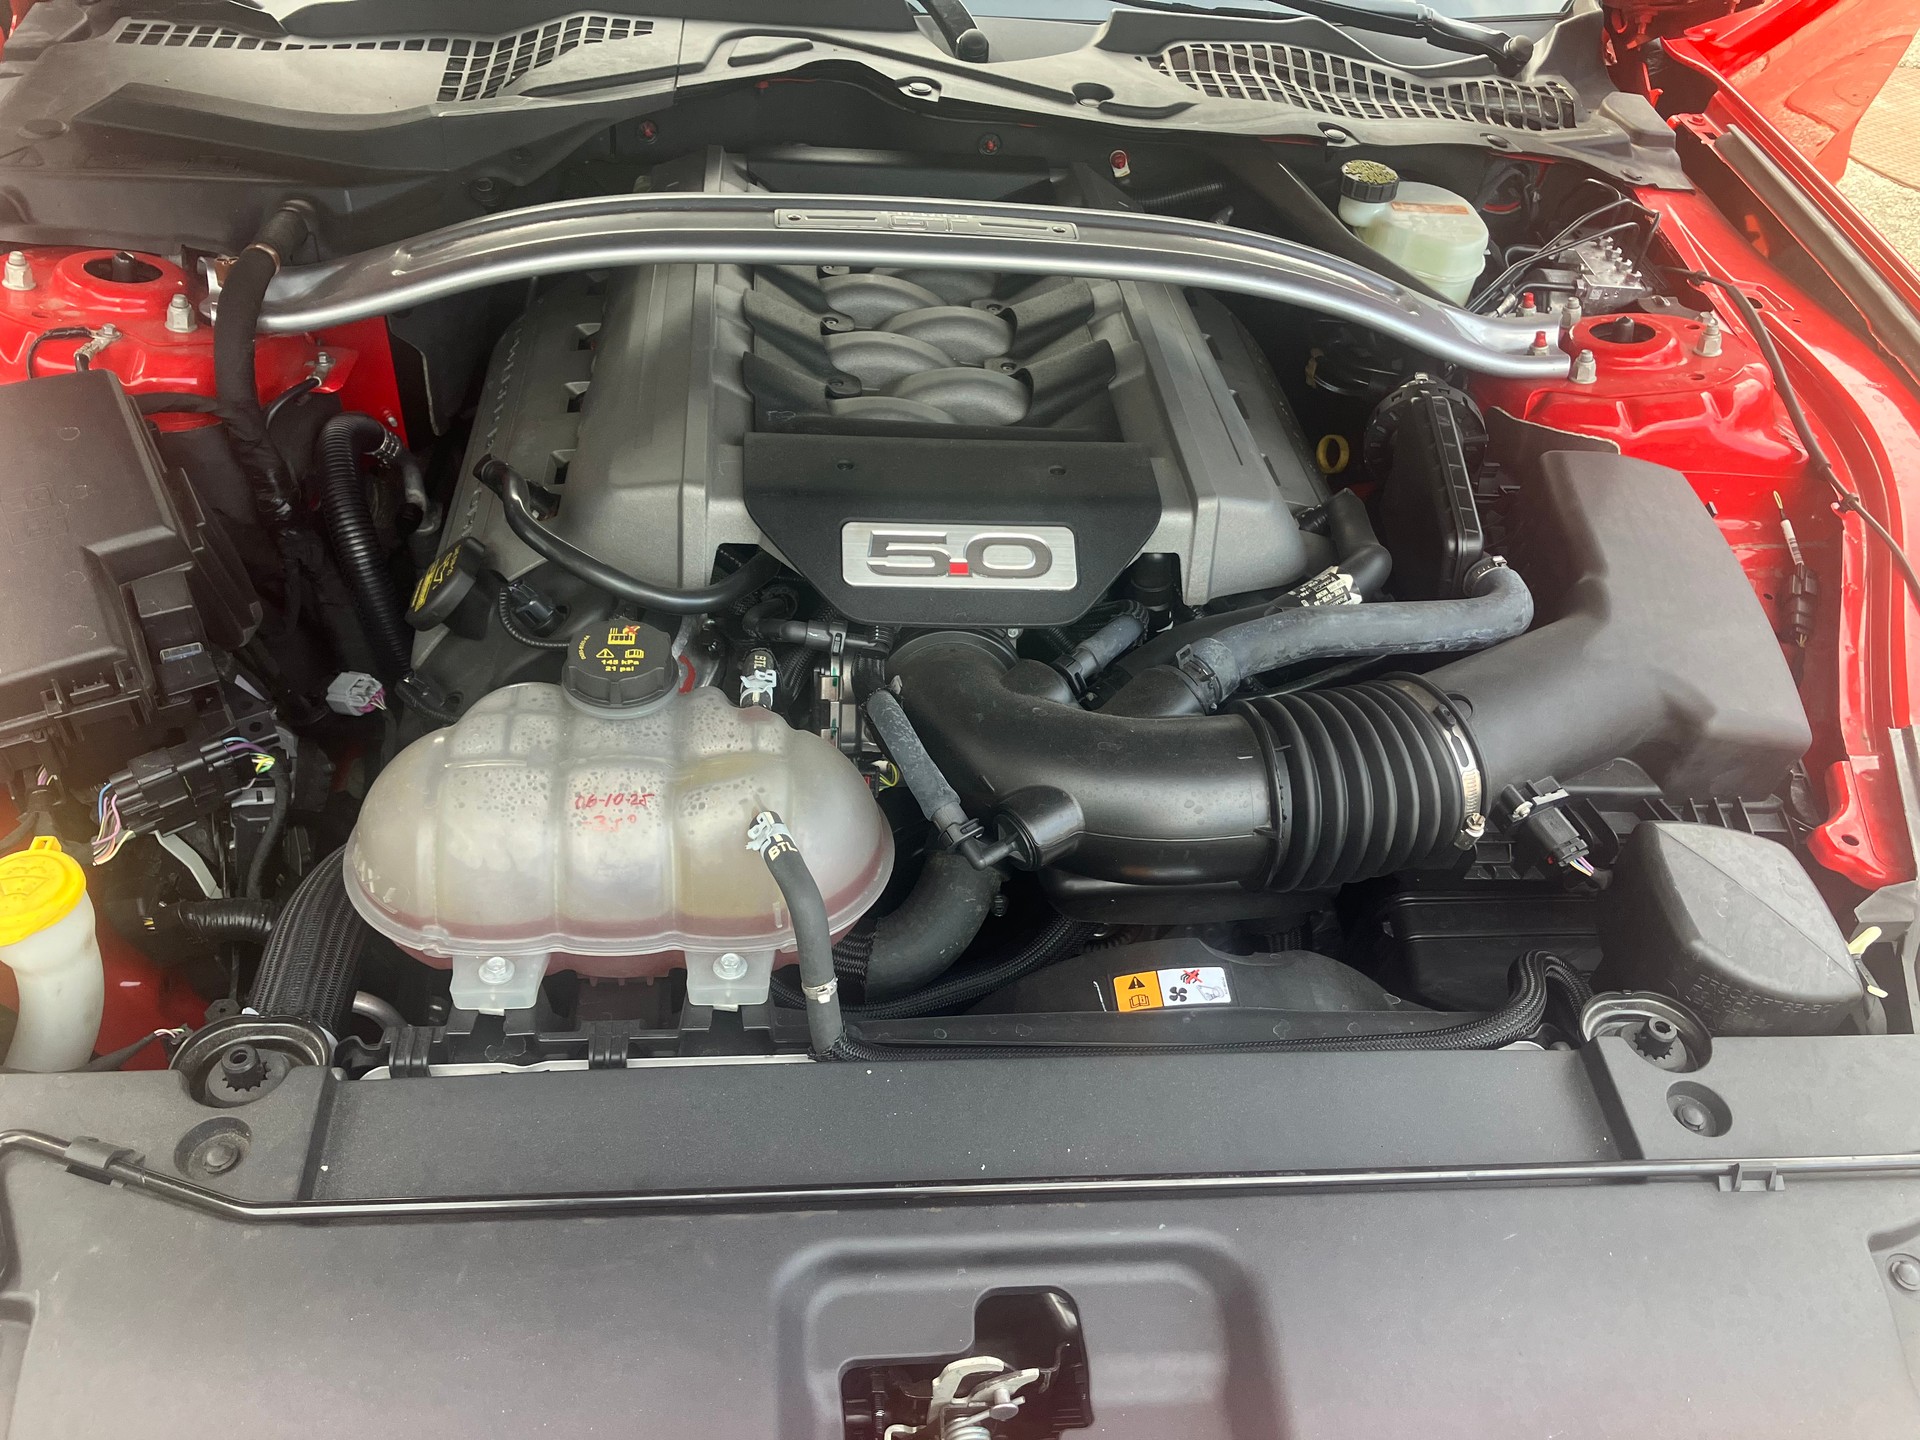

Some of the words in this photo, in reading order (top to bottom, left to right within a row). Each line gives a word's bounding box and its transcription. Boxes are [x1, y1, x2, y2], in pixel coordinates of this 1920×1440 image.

[866, 530, 1053, 579] 5.0
[619, 665, 635, 673] psi
[768, 841, 798, 861] BTL
